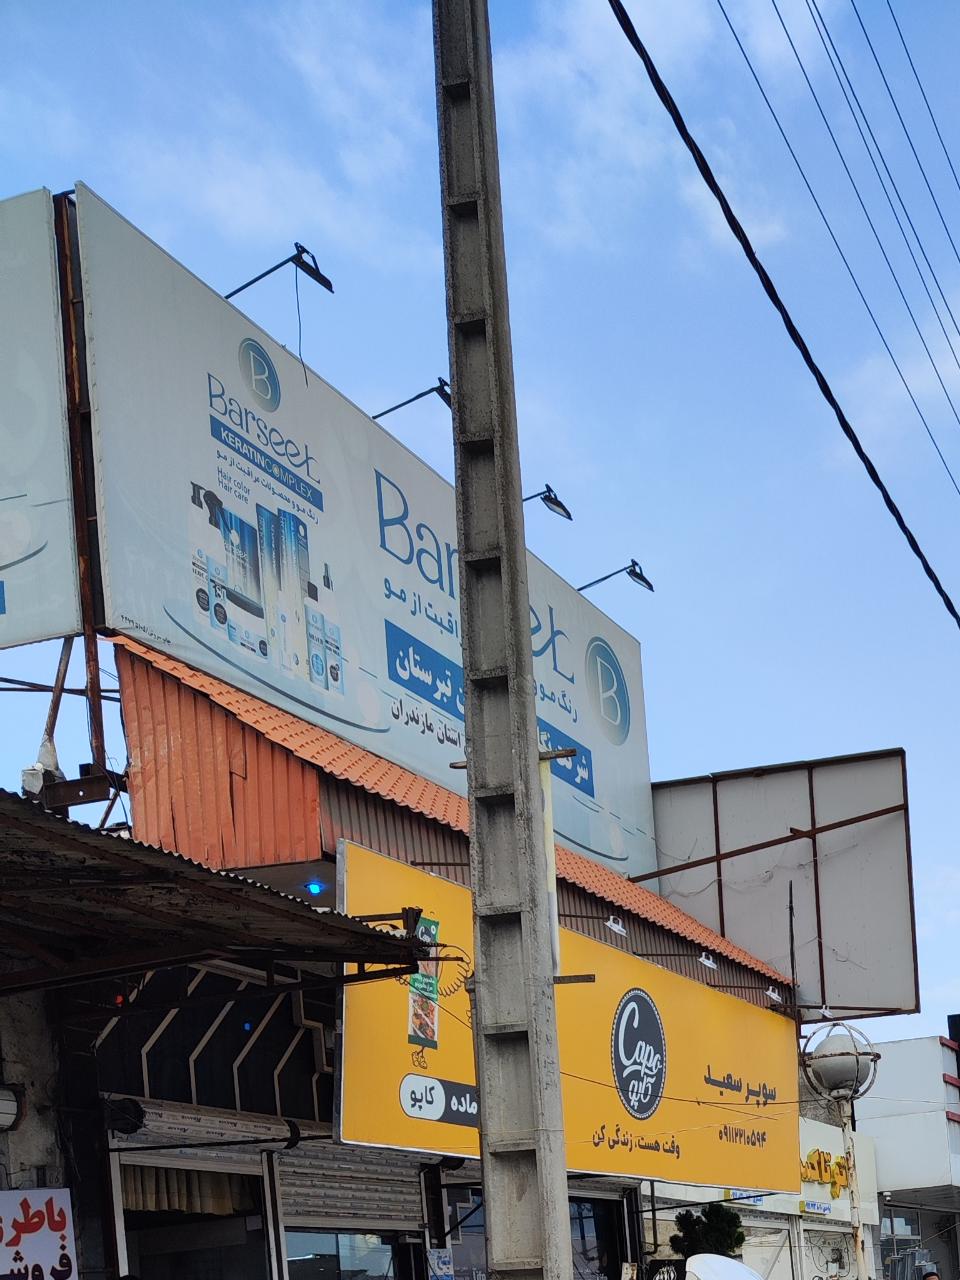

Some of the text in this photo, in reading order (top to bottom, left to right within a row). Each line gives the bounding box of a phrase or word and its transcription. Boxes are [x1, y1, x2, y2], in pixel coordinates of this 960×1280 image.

[217, 466, 251, 496] Hair color
[218, 477, 249, 504] Hair care
[384, 576, 407, 604] مو
[411, 592, 422, 617] از
[425, 602, 460, 639] اقبت
[558, 690, 578, 724] رنگ
[391, 698, 462, 748] استان مازندران
[409, 1085, 436, 1111] کاپو
[703, 1064, 777, 1108] سوپر سعید
[592, 1124, 606, 1147] کن
[607, 1124, 633, 1153] زندگی
[0, 1196, 68, 1248] باطر
